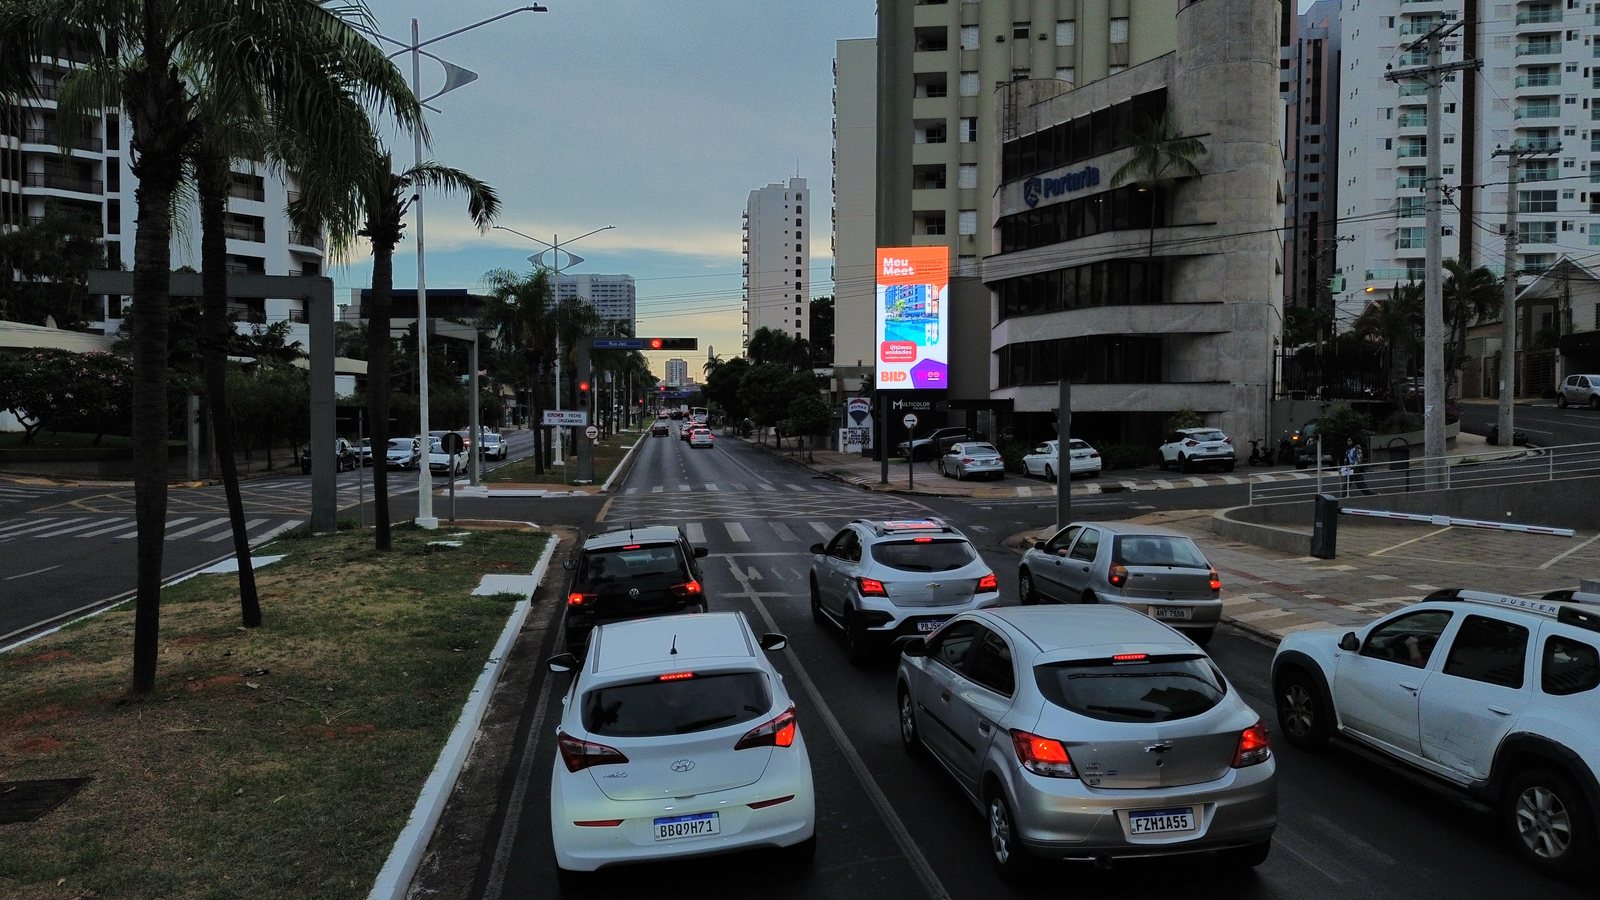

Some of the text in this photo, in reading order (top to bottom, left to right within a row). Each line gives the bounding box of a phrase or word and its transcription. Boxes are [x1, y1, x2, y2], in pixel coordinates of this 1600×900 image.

[1043, 166, 1099, 199] Portaria
[883, 257, 909, 267] Meu
[883, 267, 914, 276] Meet
[880, 371, 907, 382] BILD
[892, 399, 930, 410] MULTICOLOR
[1501, 597, 1556, 613] DUSTER
[660, 820, 712, 838] BBQ9H71
[1135, 815, 1188, 832] FZH1A55
